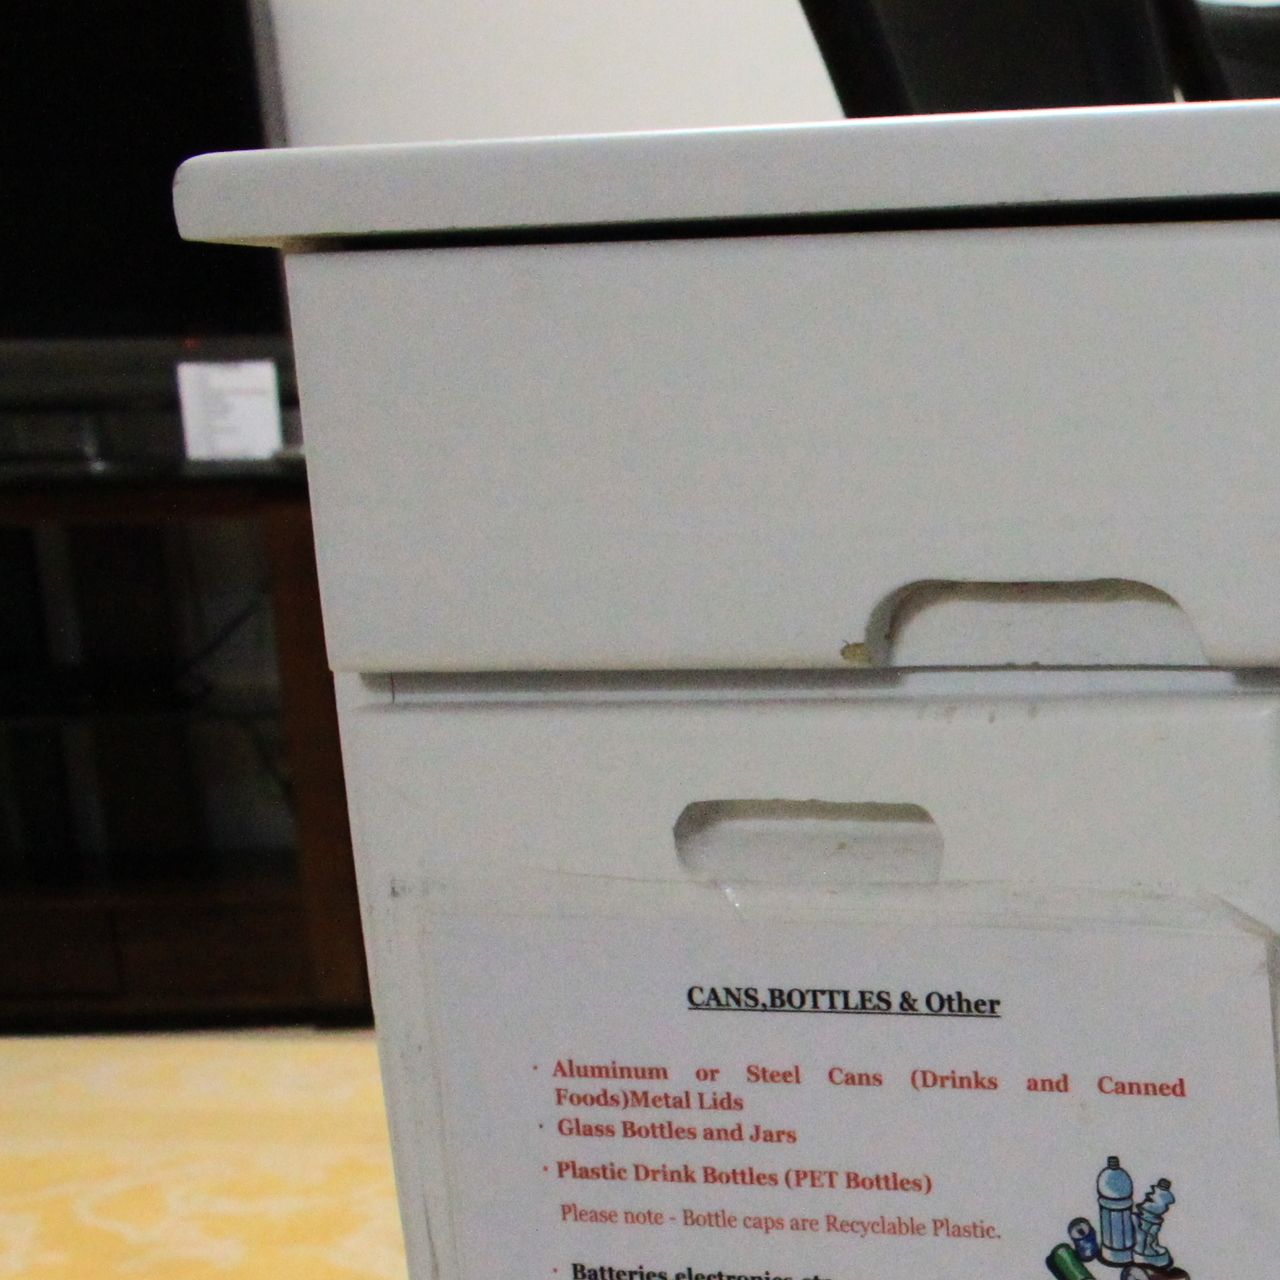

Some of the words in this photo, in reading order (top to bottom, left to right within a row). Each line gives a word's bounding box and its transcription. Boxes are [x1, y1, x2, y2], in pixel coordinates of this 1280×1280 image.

[899, 990, 919, 1013] &
[924, 990, 1001, 1015] Other
[552, 1058, 670, 1081] Aluminum
[694, 1067, 721, 1083] or
[745, 1064, 802, 1085] Steel
[827, 1066, 884, 1087] Cans
[909, 1068, 1000, 1091] (Drinks
[1025, 1072, 1071, 1094] and
[1096, 1075, 1187, 1099] Canned
[696, 1090, 745, 1112] Lids
[556, 1116, 617, 1138] Glass
[620, 1119, 699, 1141] Bottles
[701, 1122, 745, 1143] and
[748, 1123, 799, 1145] Jars
[556, 1159, 628, 1182] Plastic
[632, 1163, 698, 1184] Drink
[701, 1165, 780, 1187] Bottles
[783, 1168, 840, 1190] (PET
[844, 1170, 934, 1196] Bottles)
